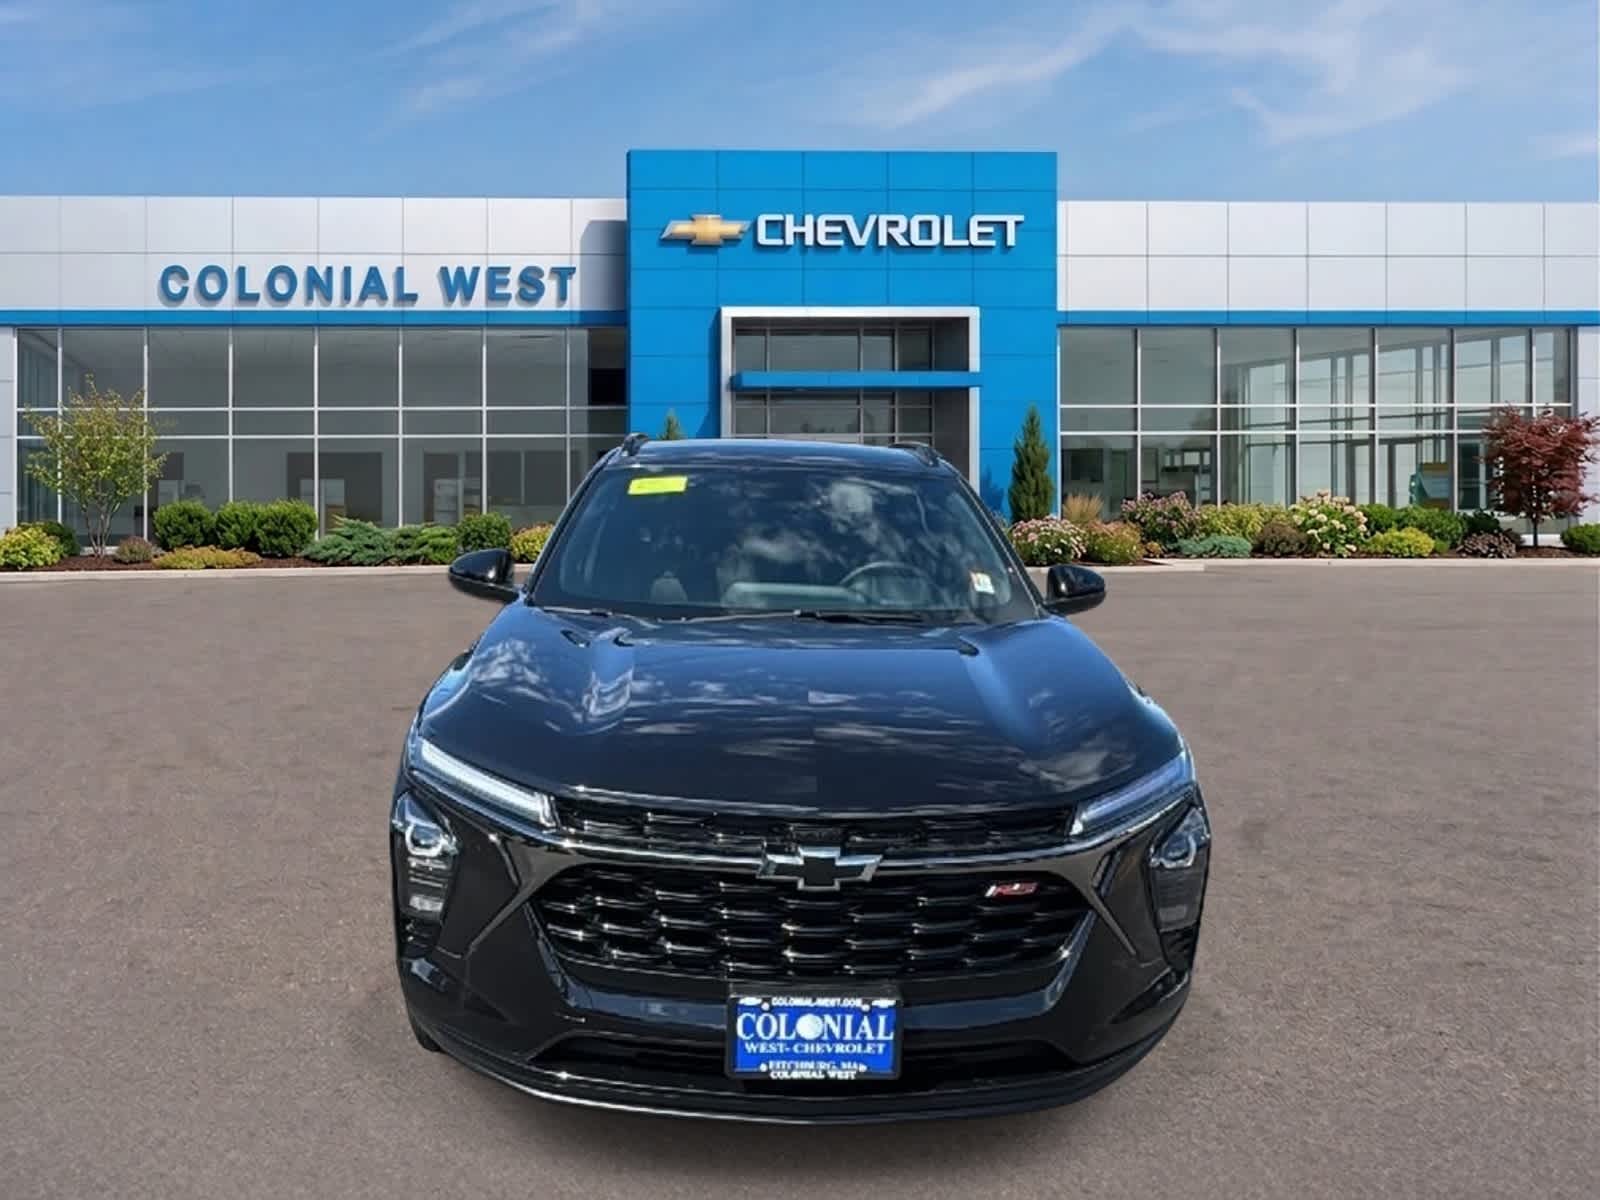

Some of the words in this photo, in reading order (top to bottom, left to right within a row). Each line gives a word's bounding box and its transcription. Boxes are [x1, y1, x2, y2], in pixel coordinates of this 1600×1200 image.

[756, 213, 1025, 247] CHEVROLET
[160, 264, 419, 307] COLONIAL
[437, 264, 578, 307] WEST
[736, 1013, 894, 1040] COLONIAL
[793, 1043, 886, 1054] CHEVROLET
[770, 1070, 824, 1080] COLONIAL
[826, 1070, 857, 1080] WEST
